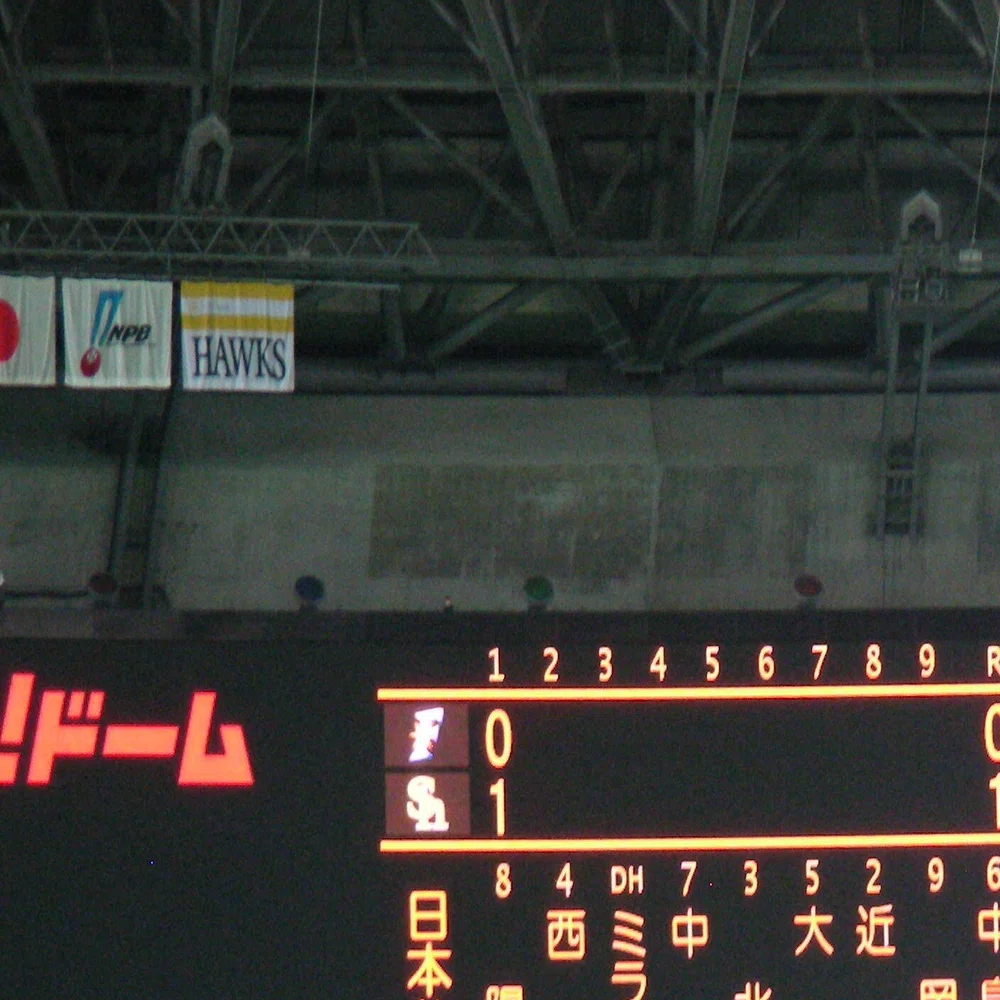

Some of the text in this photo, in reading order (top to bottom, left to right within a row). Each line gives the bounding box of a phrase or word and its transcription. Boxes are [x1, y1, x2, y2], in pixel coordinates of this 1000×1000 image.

[107, 323, 152, 344] NPB
[193, 335, 287, 381] HAWKS
[489, 648, 504, 682] 1
[543, 647, 558, 682] 2
[599, 647, 612, 682] 3
[650, 646, 667, 681] 4
[706, 646, 719, 681] 5
[758, 645, 774, 680] 6
[812, 645, 827, 680] 7
[866, 644, 881, 678] 8
[919, 643, 935, 677] 9
[485, 708, 513, 769] 0
[489, 778, 505, 836] 1
[496, 862, 511, 898] 8
[555, 862, 573, 898] 4
[611, 865, 643, 894] DH
[681, 861, 696, 896] 7
[744, 859, 757, 896] 3
[806, 859, 819, 895] 5
[866, 858, 881, 894] 2
[928, 857, 944, 893] 9
